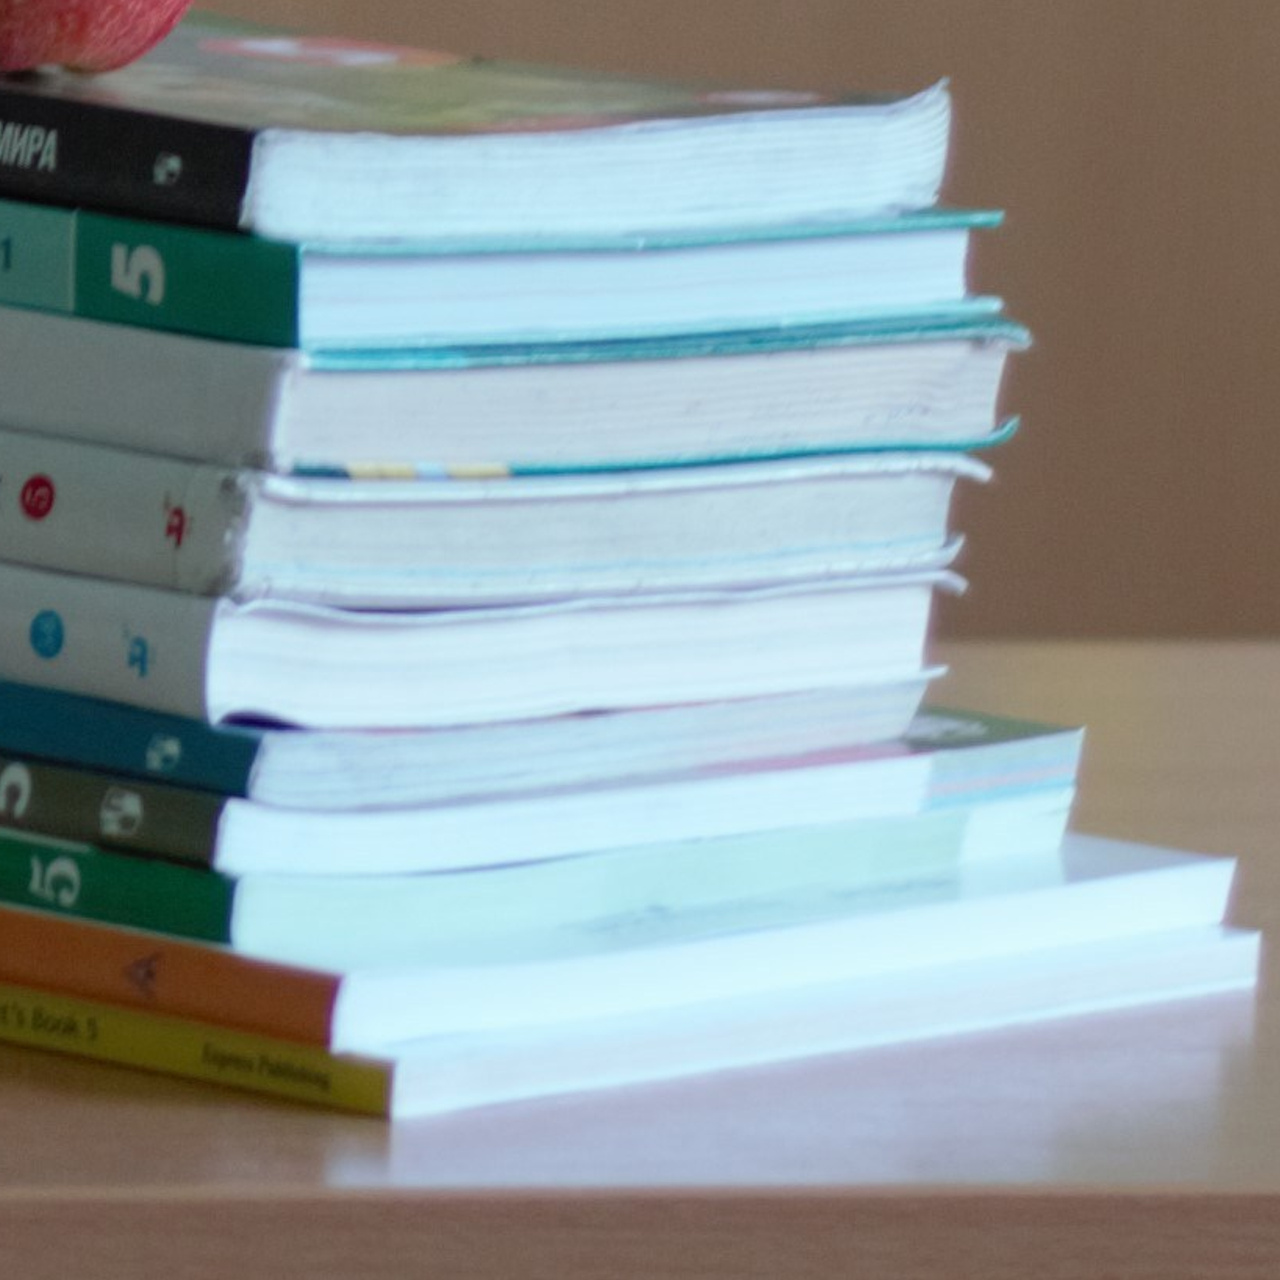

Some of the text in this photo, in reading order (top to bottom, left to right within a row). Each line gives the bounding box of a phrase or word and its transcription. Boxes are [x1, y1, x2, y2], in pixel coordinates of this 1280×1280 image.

[0, 237, 13, 271] 1
[111, 242, 165, 306] 5
[29, 856, 81, 907] 5
[30, 1004, 78, 1036] Book
